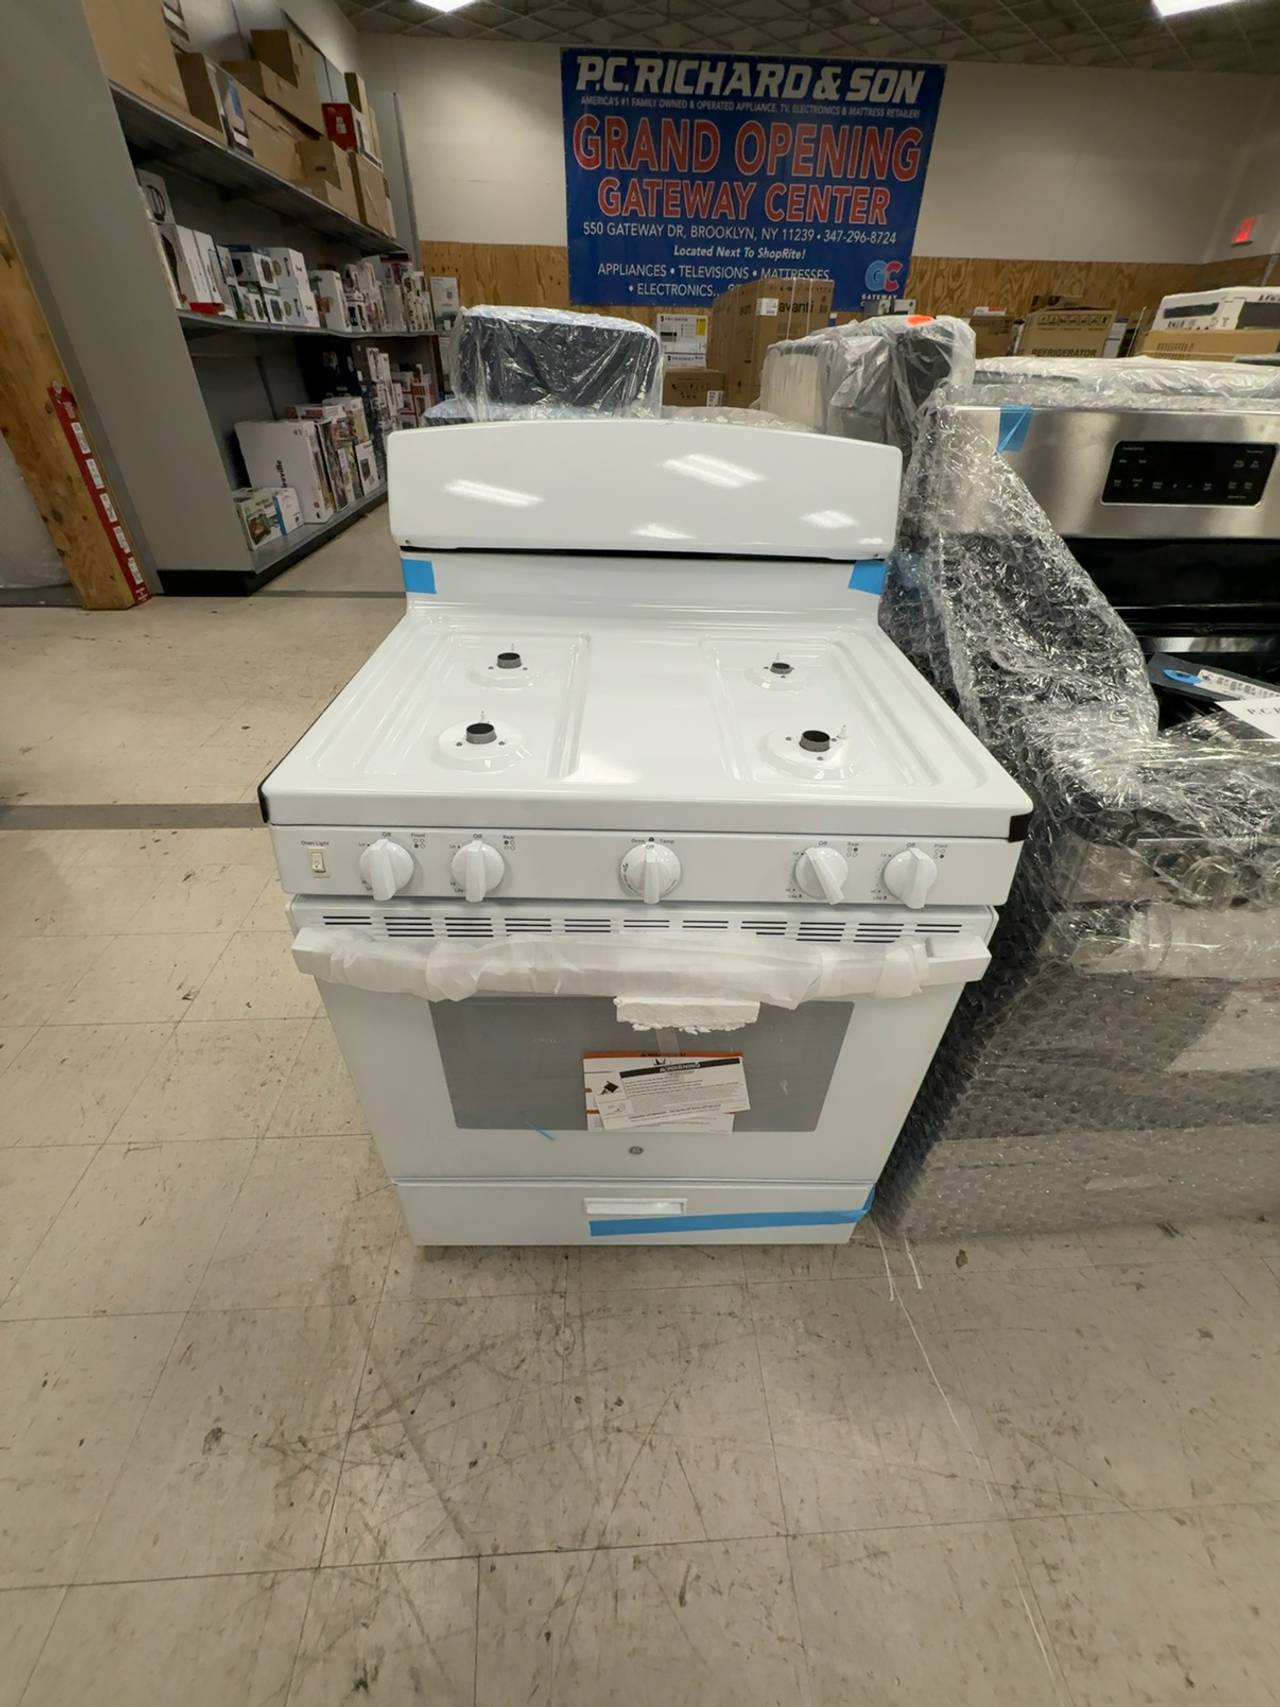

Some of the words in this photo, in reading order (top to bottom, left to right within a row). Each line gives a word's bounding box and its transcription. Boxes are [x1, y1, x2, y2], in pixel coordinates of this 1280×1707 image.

[845, 67, 926, 104] SON
[581, 96, 619, 106] AMERICA'S
[621, 97, 629, 106] #1
[631, 97, 657, 108] FAMILY
[659, 99, 687, 109] OWNED
[689, 99, 695, 110] &
[697, 100, 735, 111] OPERATED
[792, 104, 840, 115] ELECTRONICS
[842, 106, 847, 116] &
[849, 106, 885, 117] MATTRESS
[573, 113, 721, 173] GRAND
[734, 120, 924, 182] OPENING
[597, 176, 757, 220] GATEWAY
[764, 182, 891, 225] CENTER
[583, 222, 604, 235] 550
[607, 223, 665, 237] GATEWAY
[691, 226, 758, 241] BROOKLYN,
[761, 228, 781, 241] NY
[783, 228, 815, 242] 11239
[824, 231, 897, 245] 347-296-8724
[674, 245, 714, 257] Located
[717, 247, 741, 258] Next
[744, 248, 755, 258] To
[758, 248, 806, 261] ShopRite!
[598, 263, 667, 277] APPLIANCES
[679, 265, 749, 279] TELEVISIONS
[778, 300, 814, 313] avanti
